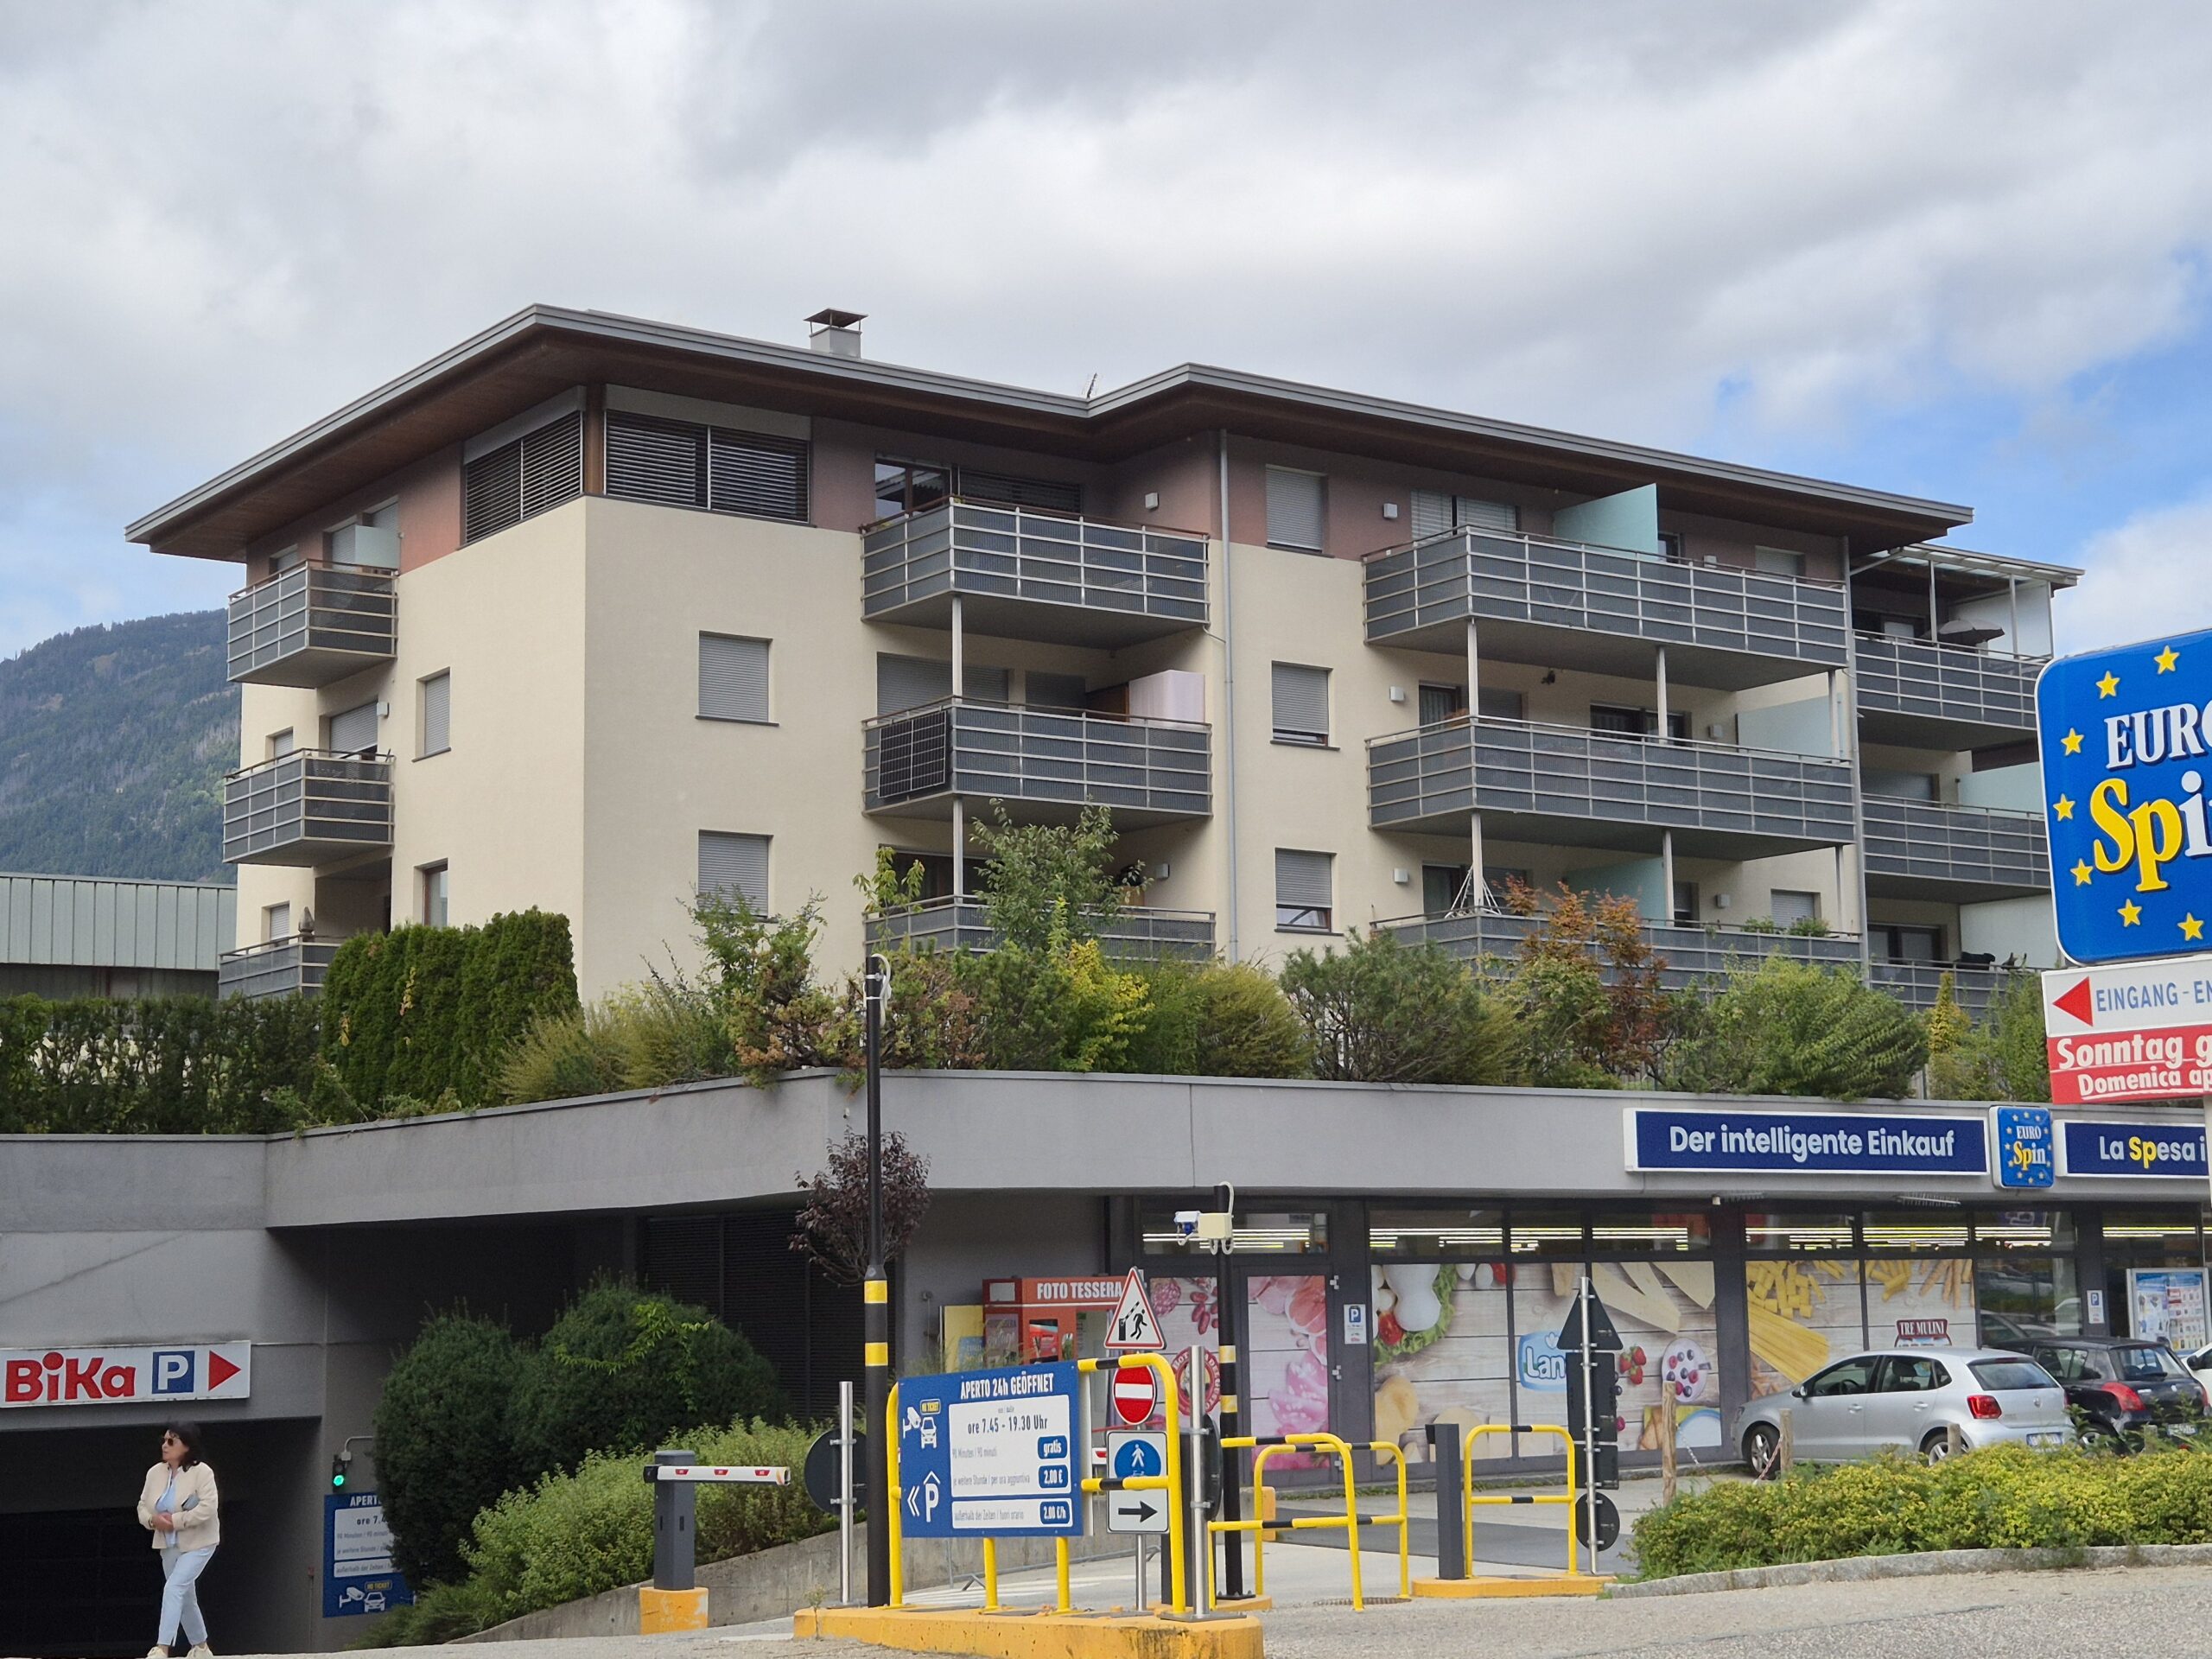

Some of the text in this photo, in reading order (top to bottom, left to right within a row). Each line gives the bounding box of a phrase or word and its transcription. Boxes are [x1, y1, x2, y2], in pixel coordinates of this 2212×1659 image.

[2090, 771, 2212, 892] Spi
[2096, 982, 2178, 1012] EINGANG
[2057, 1034, 2183, 1070] Sonntag
[2077, 1065, 2181, 1096] Domenica
[1669, 1124, 1955, 1162] Der intelligente Einkauf
[2016, 1125, 2042, 1140] EURO
[2013, 1141, 2047, 1171] Spin
[2100, 1135, 2124, 1160] La
[2128, 1136, 2196, 1169] Spesa
[1037, 1281, 1122, 1300] FOTO TESSERA
[1351, 1308, 1359, 1322] P
[1899, 1320, 1944, 1336] TRE MULINI
[5, 1351, 189, 1402] BiKa P
[1526, 1346, 1566, 1380] Lan
[961, 1371, 1054, 1400] APERTO 24h GEÖFFNET
[968, 1423, 979, 1434] ore
[982, 1418, 999, 1433] 7.45
[1008, 1415, 1031, 1431] 19.30
[1033, 1414, 1048, 1430] Uhr
[1043, 1440, 1062, 1458] gratis
[350, 1495, 381, 1507] APERT
[925, 1483, 939, 1522] P
